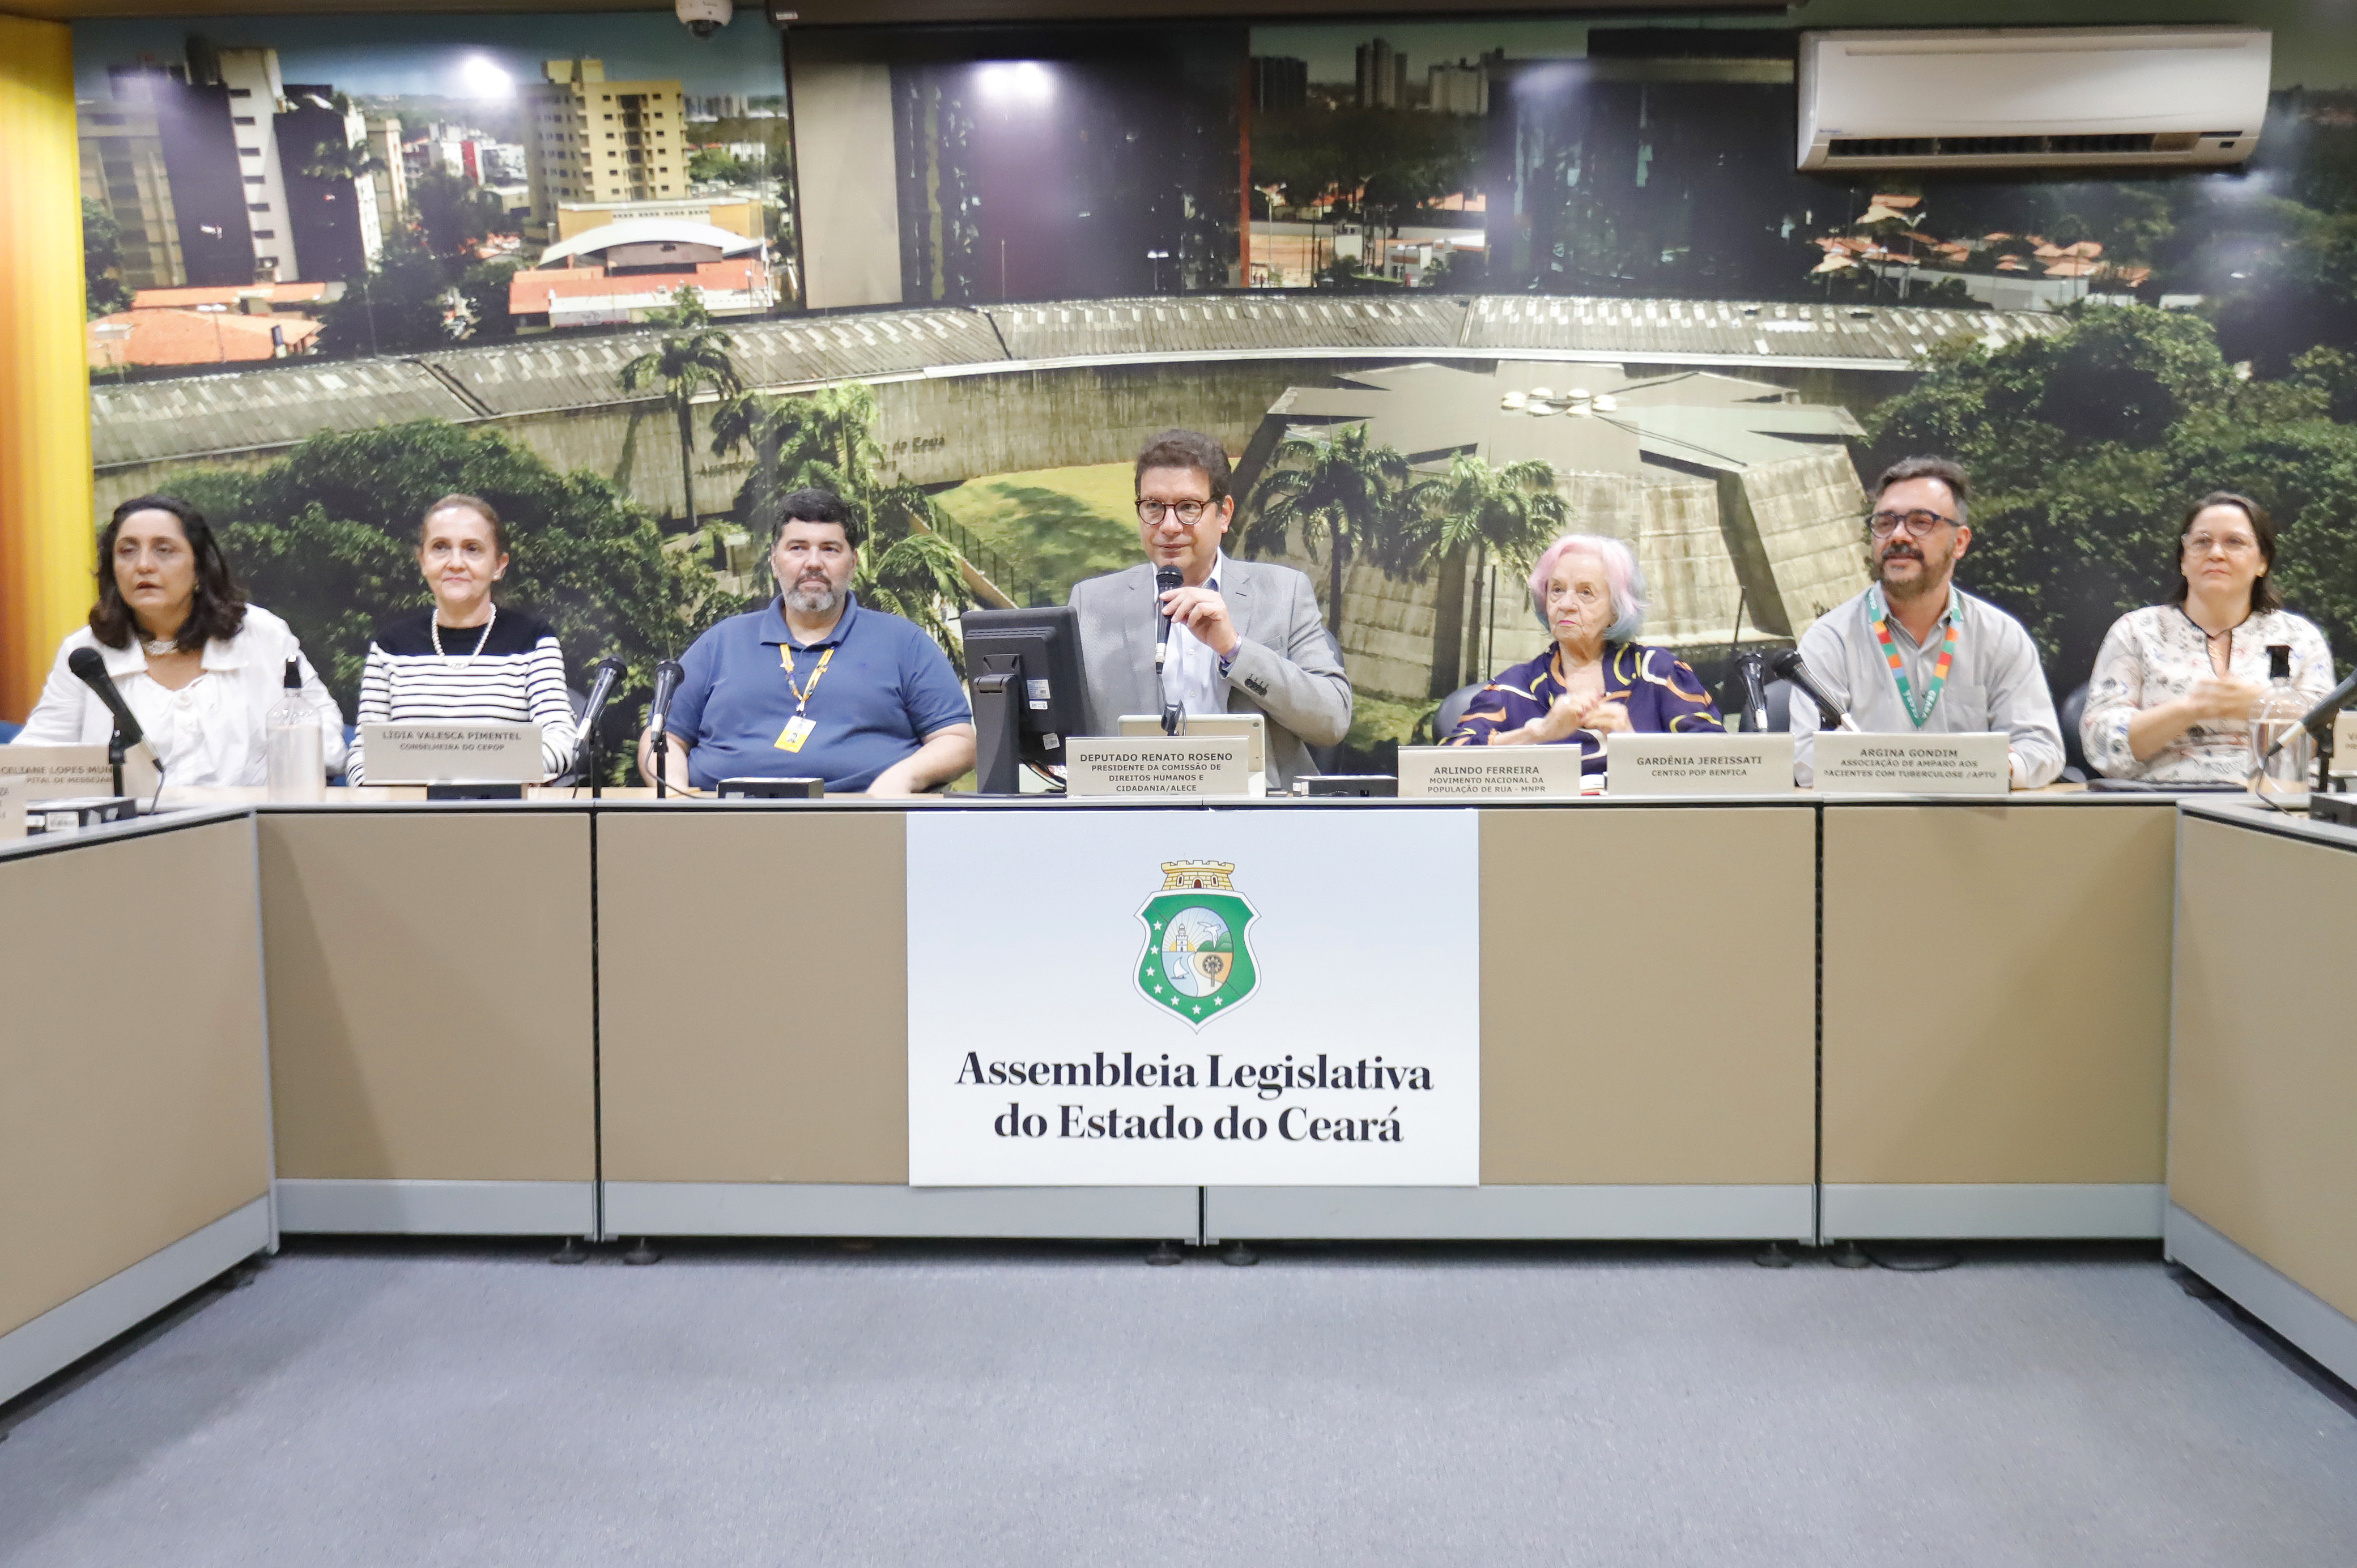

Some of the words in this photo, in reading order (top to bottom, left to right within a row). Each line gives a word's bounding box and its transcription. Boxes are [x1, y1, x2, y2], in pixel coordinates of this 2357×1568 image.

[382, 729, 414, 739] LÍDIA
[416, 731, 463, 740] VALESCA
[467, 731, 522, 740] PIMENTEL
[1860, 748, 1905, 757] ARGINA
[1909, 748, 1958, 757] GONDIM
[1637, 755, 1695, 765] GARDÊNIA
[1697, 756, 1763, 765] JEREISSATI
[1841, 759, 1899, 767] ASSOCIAÇÃO
[1428, 785, 1478, 794] POPULAÇÃO
[954, 1050, 1199, 1087] Assembleia
[1206, 1053, 1434, 1101] Legislativa
[994, 1101, 1048, 1138] do
[1057, 1103, 1203, 1140] Estado
[1214, 1105, 1267, 1140] do
[1278, 1105, 1405, 1142] Ceará
